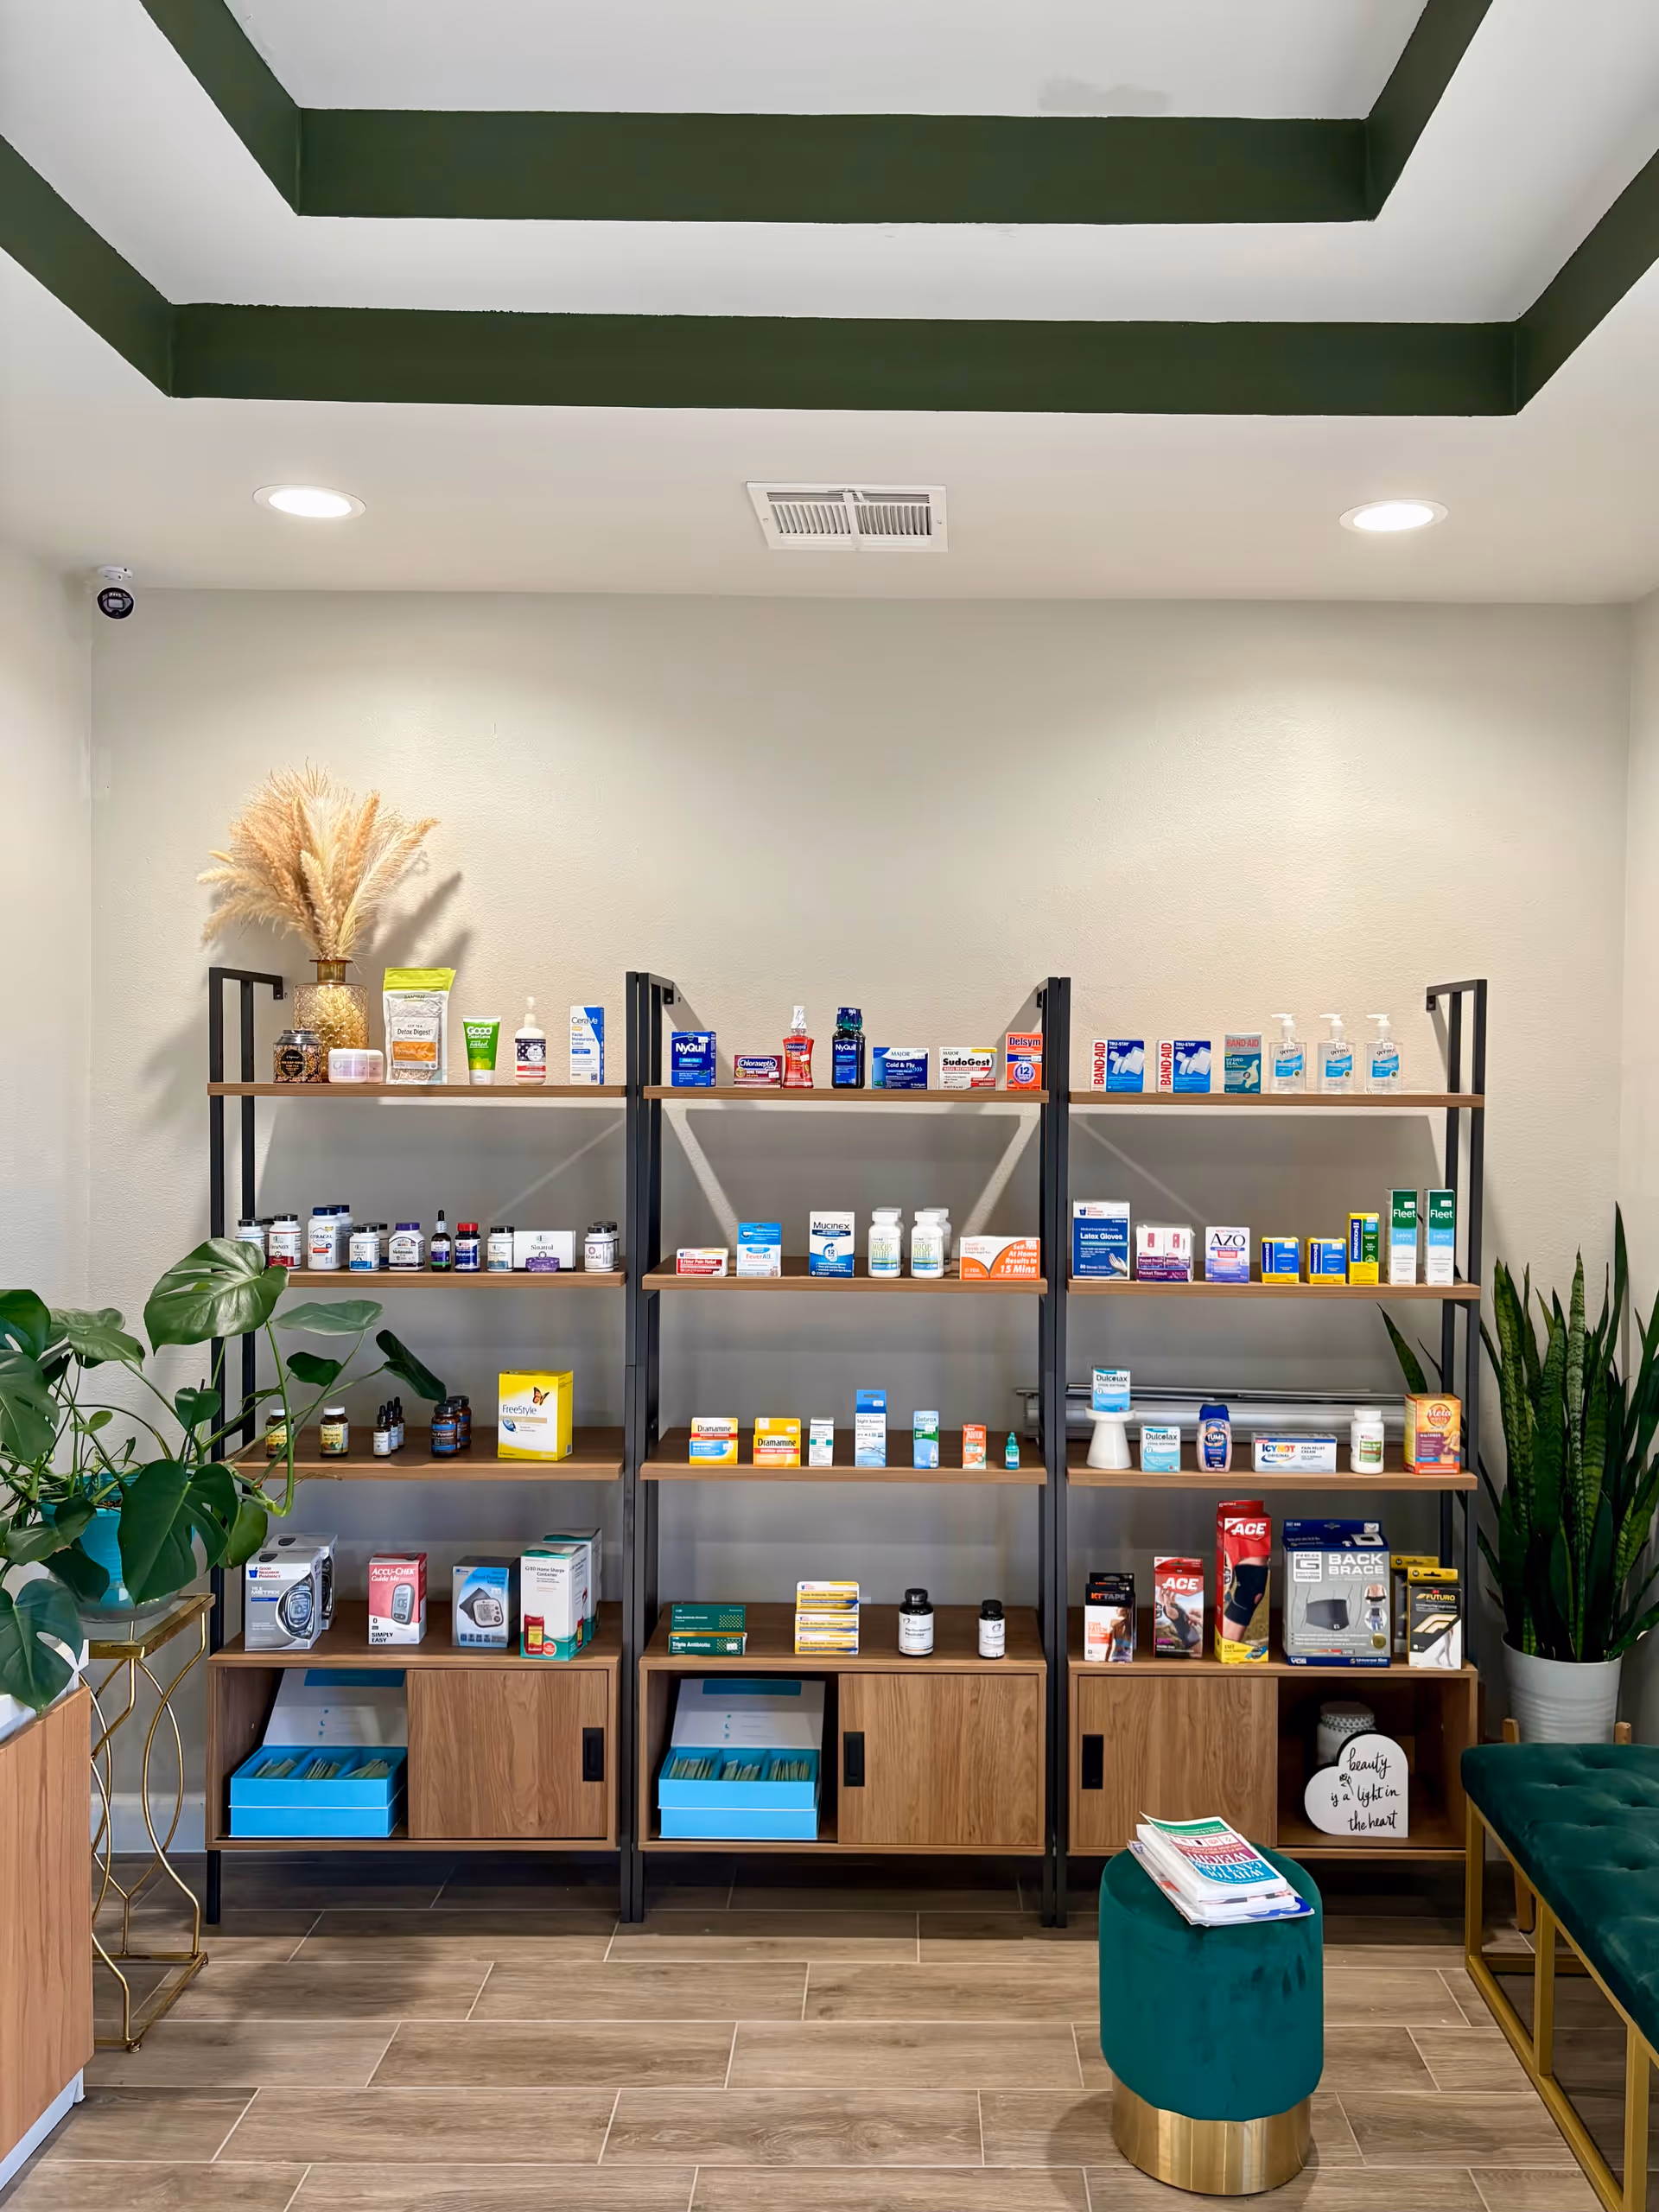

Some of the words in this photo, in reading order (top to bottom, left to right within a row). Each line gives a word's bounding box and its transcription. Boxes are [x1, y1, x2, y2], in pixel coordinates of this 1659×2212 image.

[1009, 1037, 1040, 1046] Delsym
[1226, 1039, 1259, 1047] BAND-AID
[676, 1043, 706, 1054] NyQuil
[740, 1058, 774, 1068] Chloraseptic
[1094, 1042, 1106, 1084] BAND-AID
[1160, 1042, 1173, 1085] BAND-AID
[1394, 1209, 1416, 1217] Fleet
[1430, 1210, 1452, 1218] Fleet
[1211, 1233, 1245, 1247] AZO
[1013, 1265, 1035, 1274] Mins
[502, 1405, 537, 1415] FreeStyle
[758, 1438, 796, 1447] Dramamine
[1231, 1522, 1266, 1535] ACE
[1328, 1553, 1383, 1565] BACK
[1328, 1565, 1384, 1574] BRACE
[1162, 1577, 1199, 1590] ACE
[1347, 1747, 1391, 1780] beauty
[1357, 1783, 1384, 1808] light
[1385, 1785, 1401, 1796] in
[1348, 1810, 1367, 1832] the
[1369, 1809, 1398, 1829] heart
[1234, 1870, 1264, 1878] WHY
